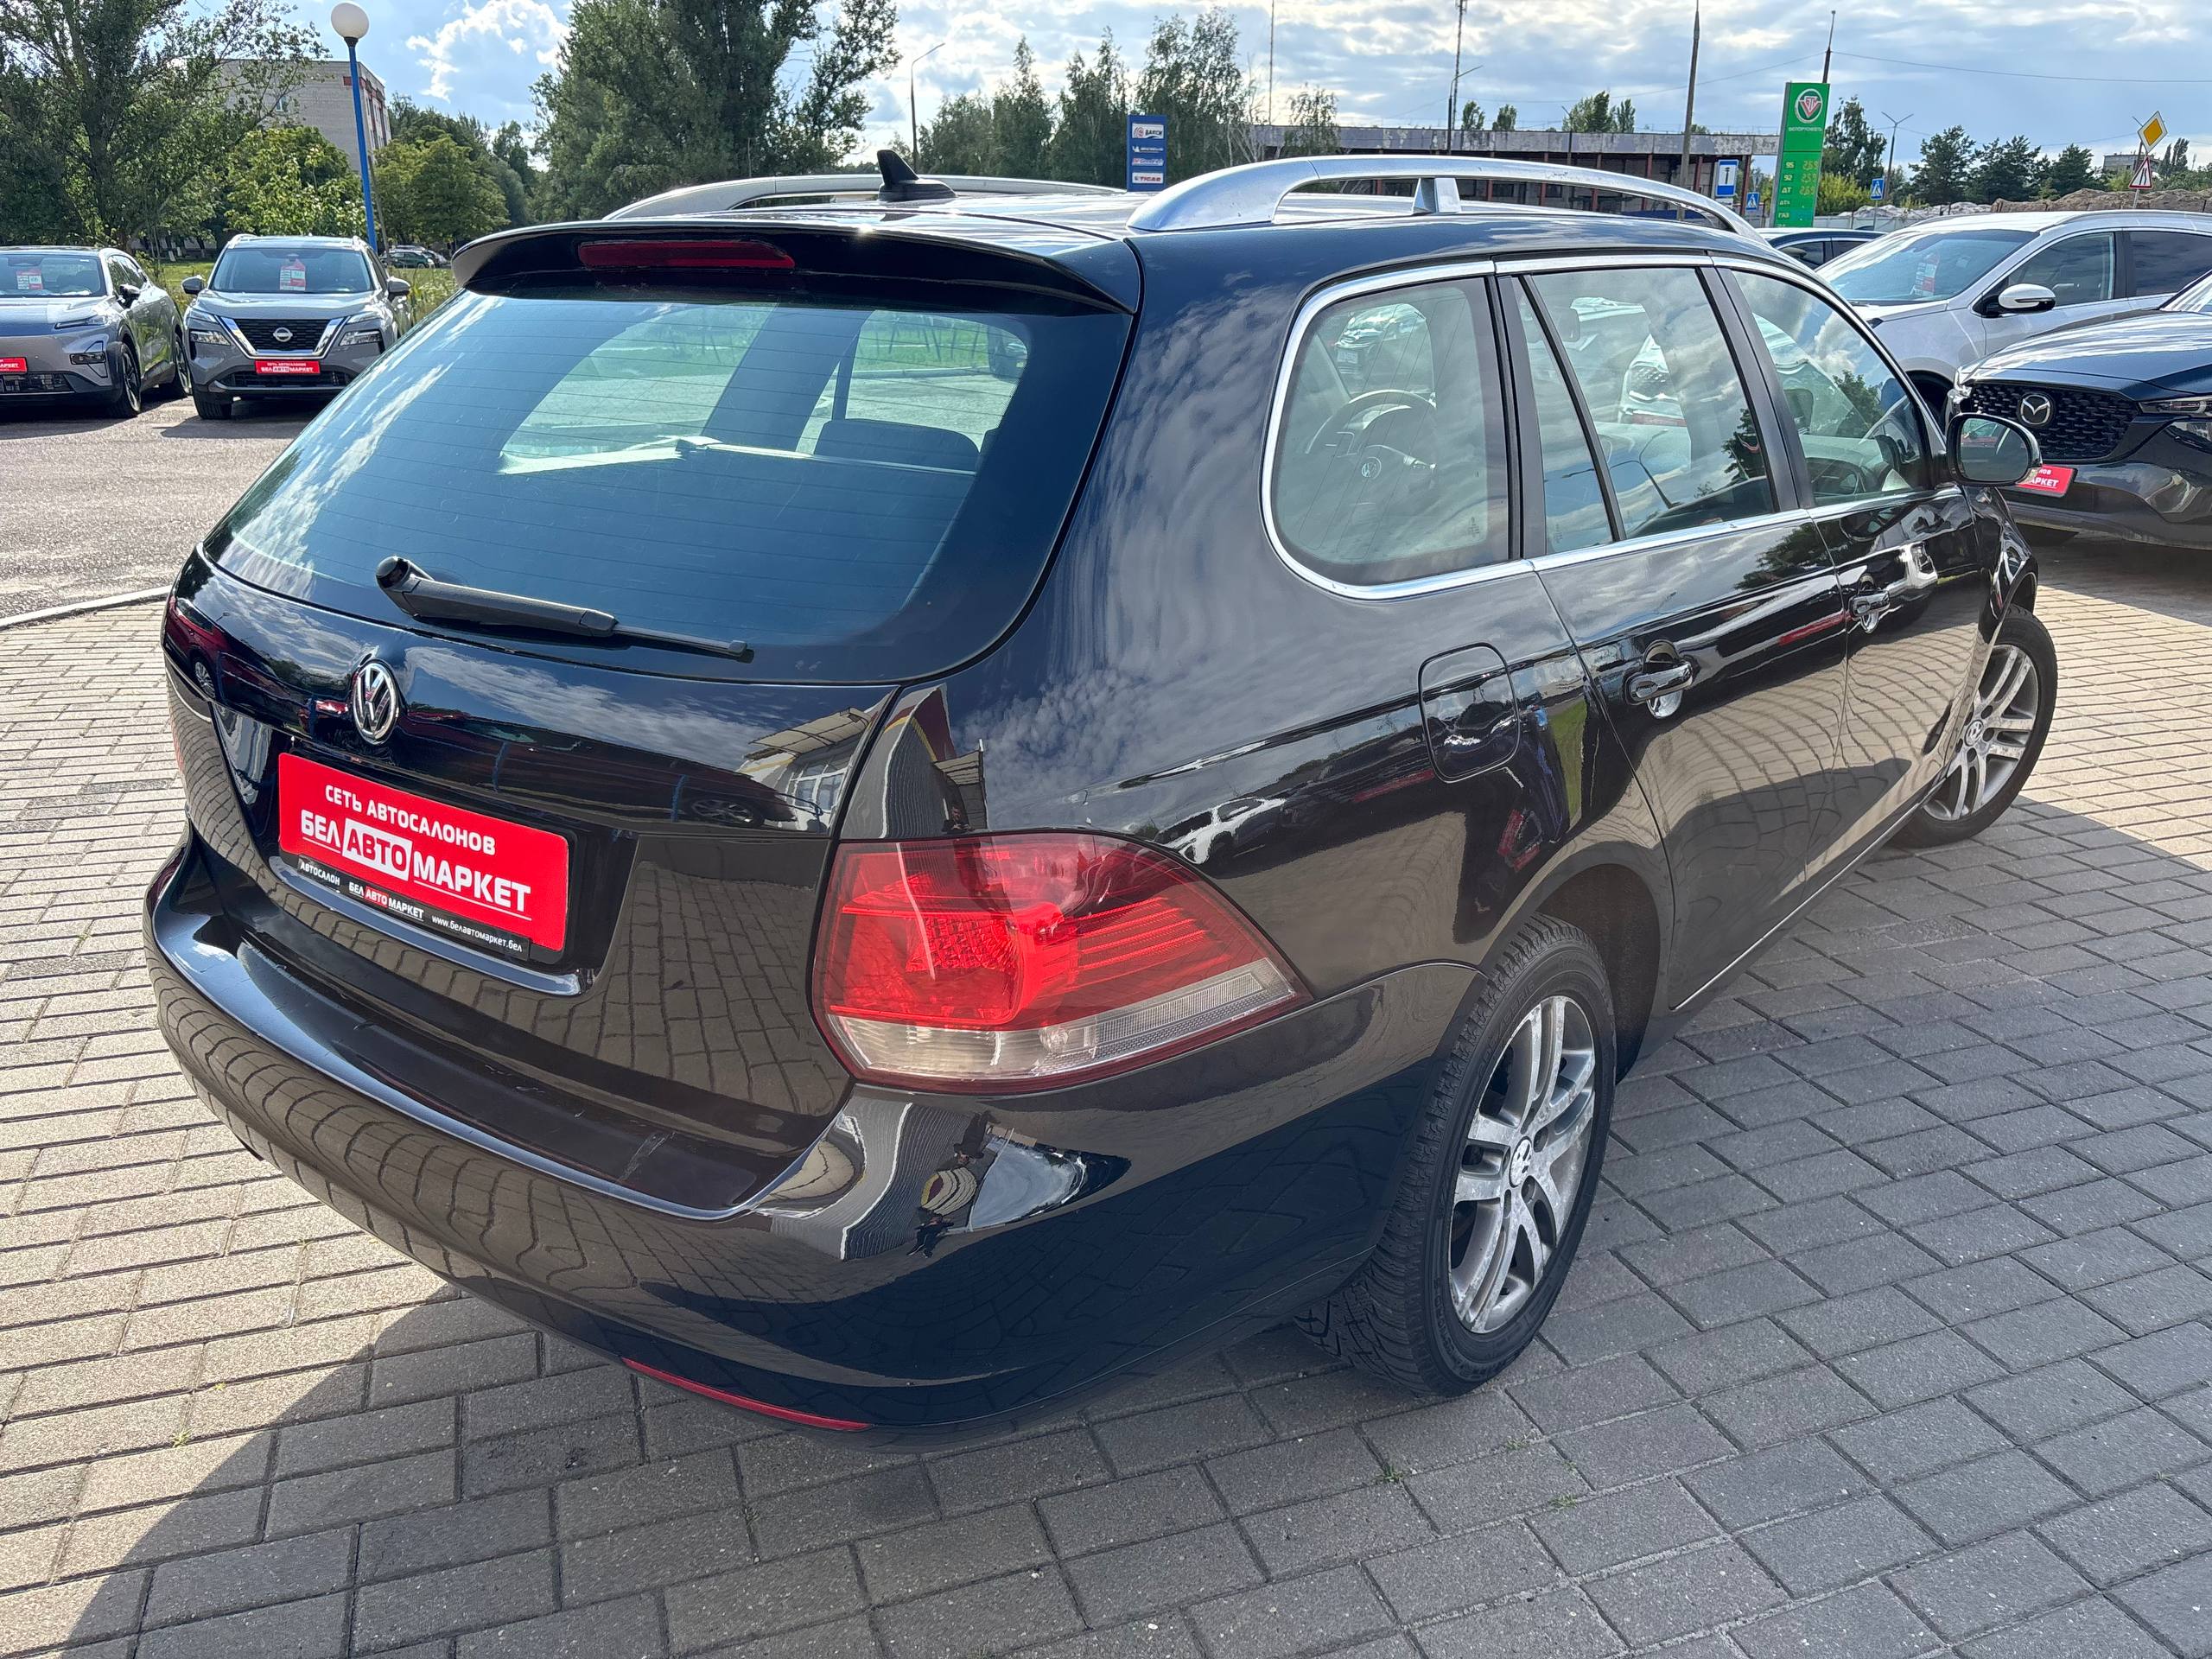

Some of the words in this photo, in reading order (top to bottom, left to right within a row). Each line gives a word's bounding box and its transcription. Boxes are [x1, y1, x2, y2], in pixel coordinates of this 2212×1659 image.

[325, 785, 362, 813] СЕТЬ
[366, 799, 496, 855] АВТОСАЛОНОВ
[299, 861, 340, 886] АВТОСАЛОН
[431, 915, 523, 952] www.белавтомаркет.бел
